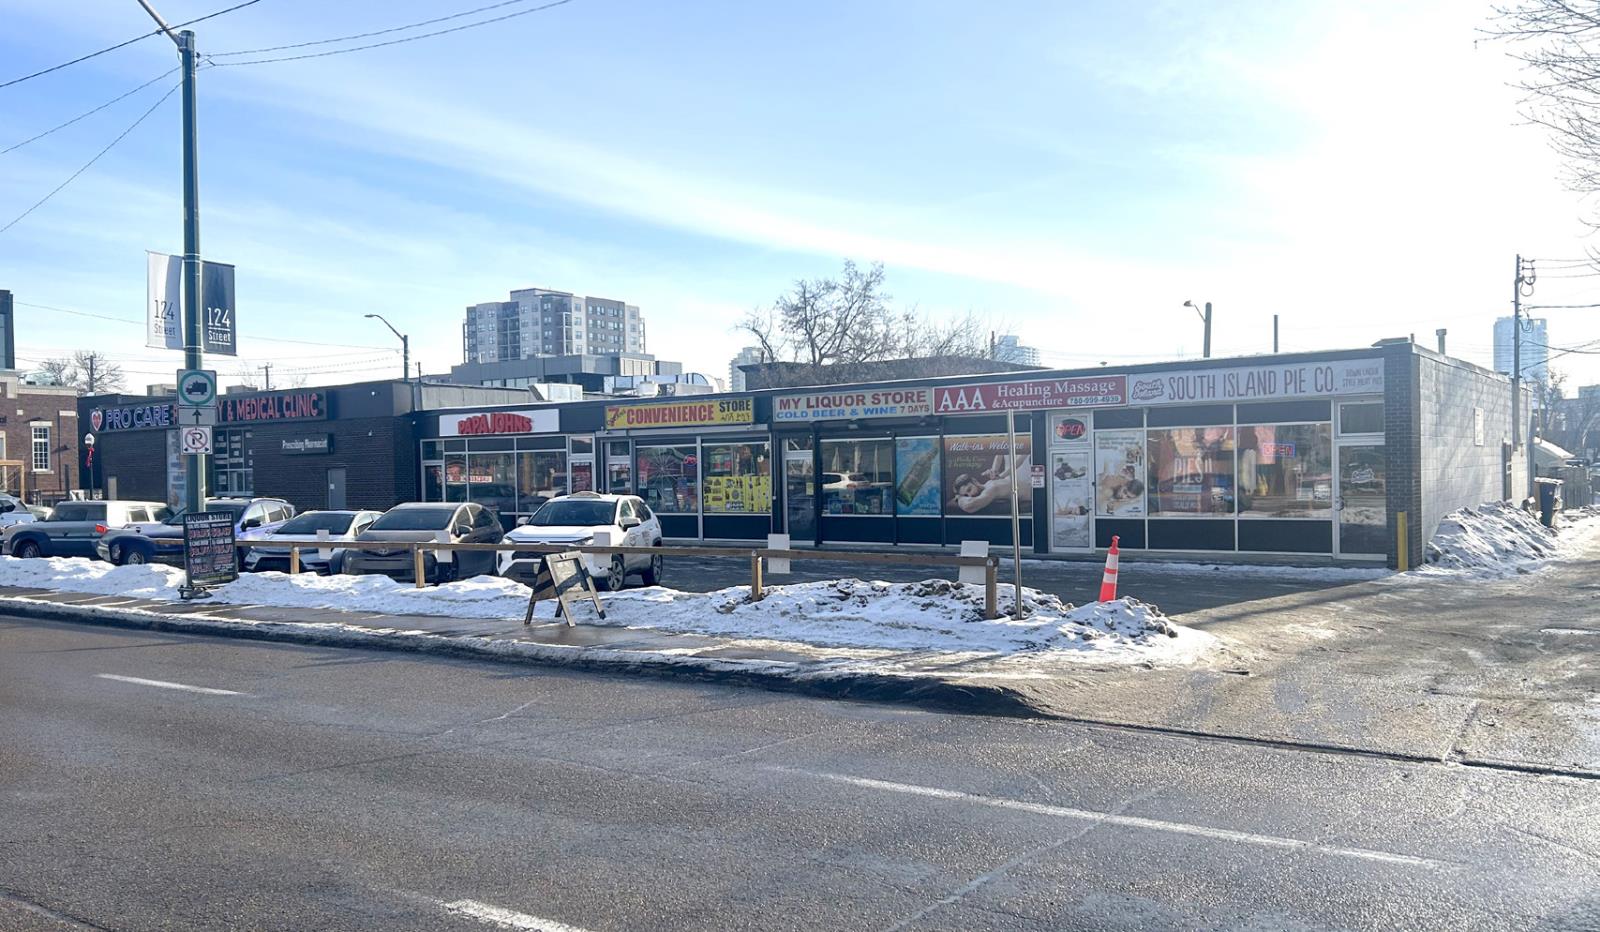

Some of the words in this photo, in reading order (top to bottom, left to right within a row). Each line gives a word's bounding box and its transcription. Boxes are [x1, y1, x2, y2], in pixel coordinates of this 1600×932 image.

[154, 300, 175, 320] 124
[207, 307, 231, 327] 124
[154, 322, 176, 336] Street
[208, 330, 231, 342] Street
[997, 383, 1051, 399] Healing
[1054, 380, 1116, 395] Massage
[1168, 374, 1216, 400] SOUTH
[1223, 370, 1276, 398] ISLAND
[1284, 368, 1306, 394] PIE
[1314, 366, 1338, 392] CO.
[226, 400, 234, 422] &
[236, 396, 281, 421] MEDICAL
[283, 393, 318, 418] CLINIC
[719, 400, 751, 413] STORE
[779, 398, 801, 410] MY
[806, 393, 865, 409] LIQUOR
[871, 390, 926, 405] STORE
[900, 406, 905, 414] 7
[907, 404, 930, 414] DAYS
[938, 388, 986, 412] AAA
[105, 408, 132, 430] PRO
[133, 405, 169, 427] CARE
[626, 404, 714, 424] CONVENIENCE
[776, 410, 808, 419] COLD
[812, 407, 846, 418] BEER
[850, 408, 859, 416] &
[863, 406, 897, 416] WINE
[458, 414, 489, 434] PAPA
[489, 412, 532, 433] JOHNS
[1056, 423, 1086, 436] OPEN
[1263, 444, 1293, 455] OPEN
